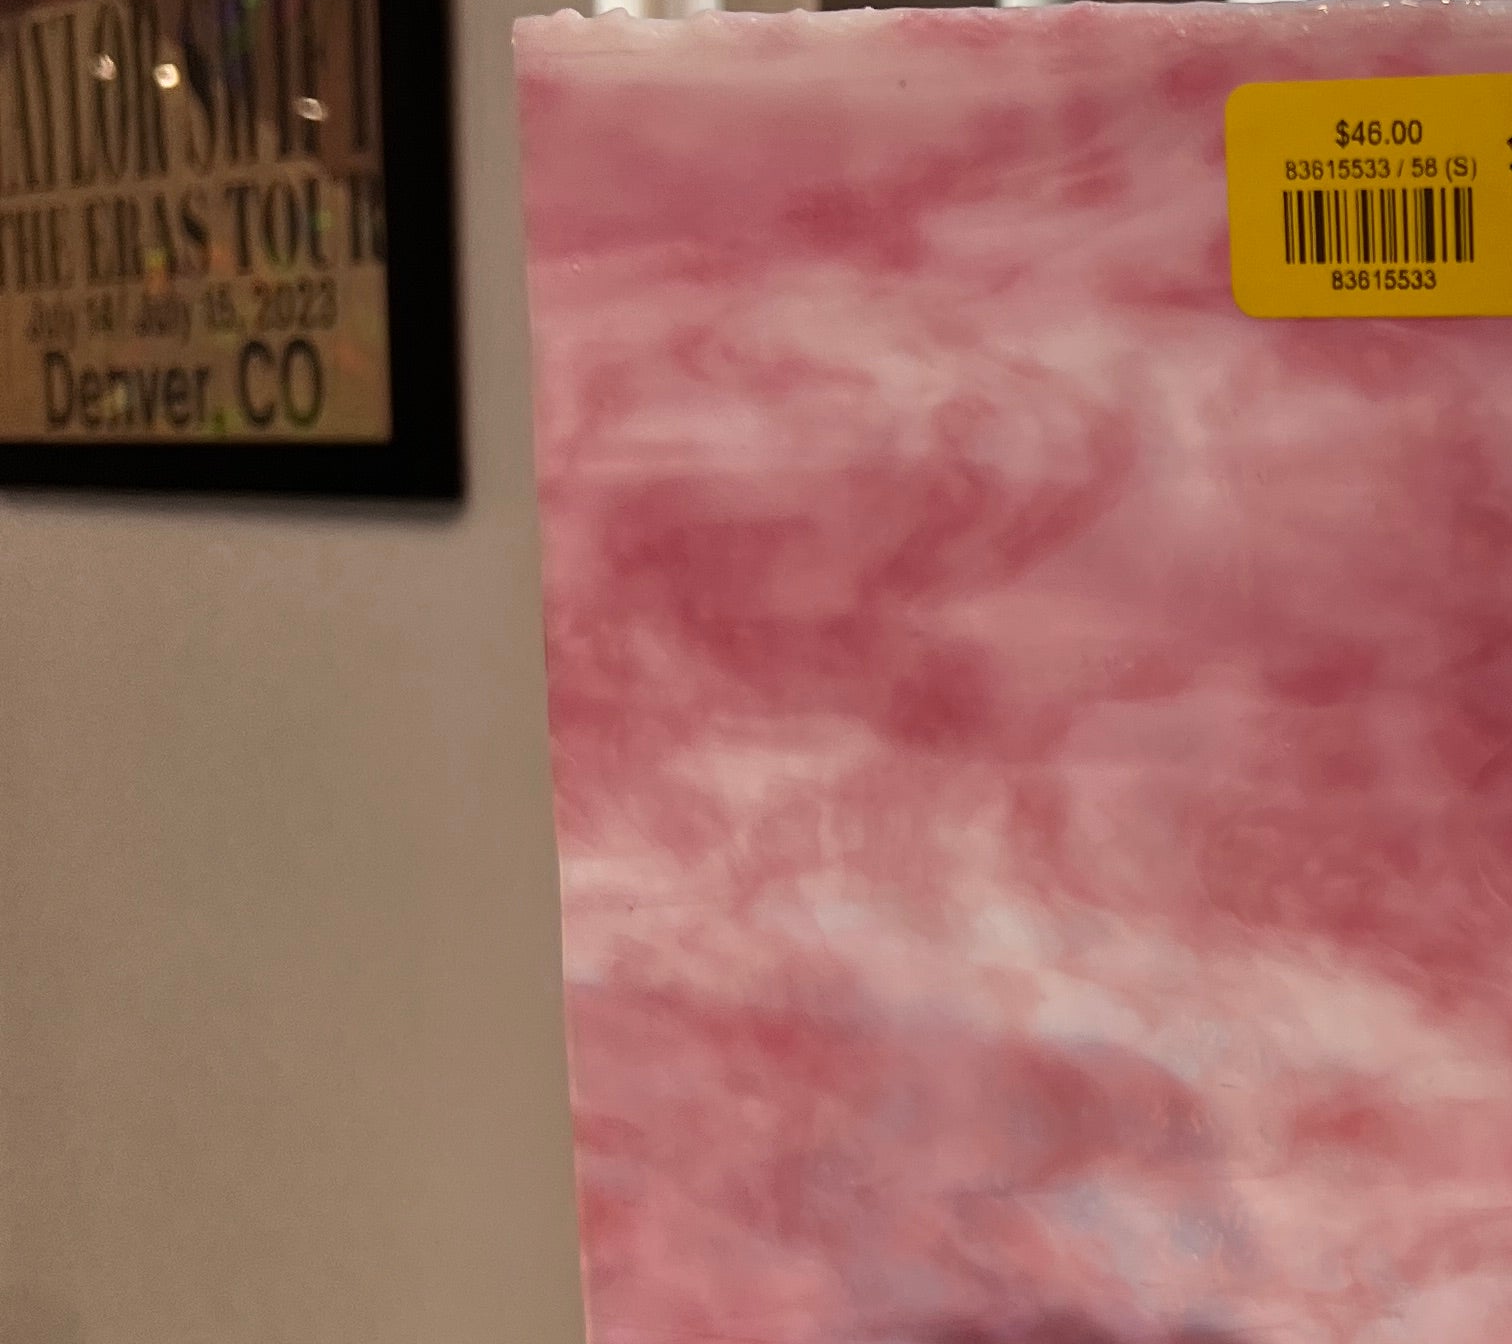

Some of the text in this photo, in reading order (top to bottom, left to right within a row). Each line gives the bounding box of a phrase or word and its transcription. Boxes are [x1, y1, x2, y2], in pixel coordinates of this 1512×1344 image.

[1335, 119, 1423, 149] $46.00
[1285, 158, 1391, 181] 83615533
[1411, 158, 1438, 177] 58
[1445, 157, 1477, 182] (S)
[1332, 269, 1437, 291] 83615533
[237, 338, 325, 429] CO
